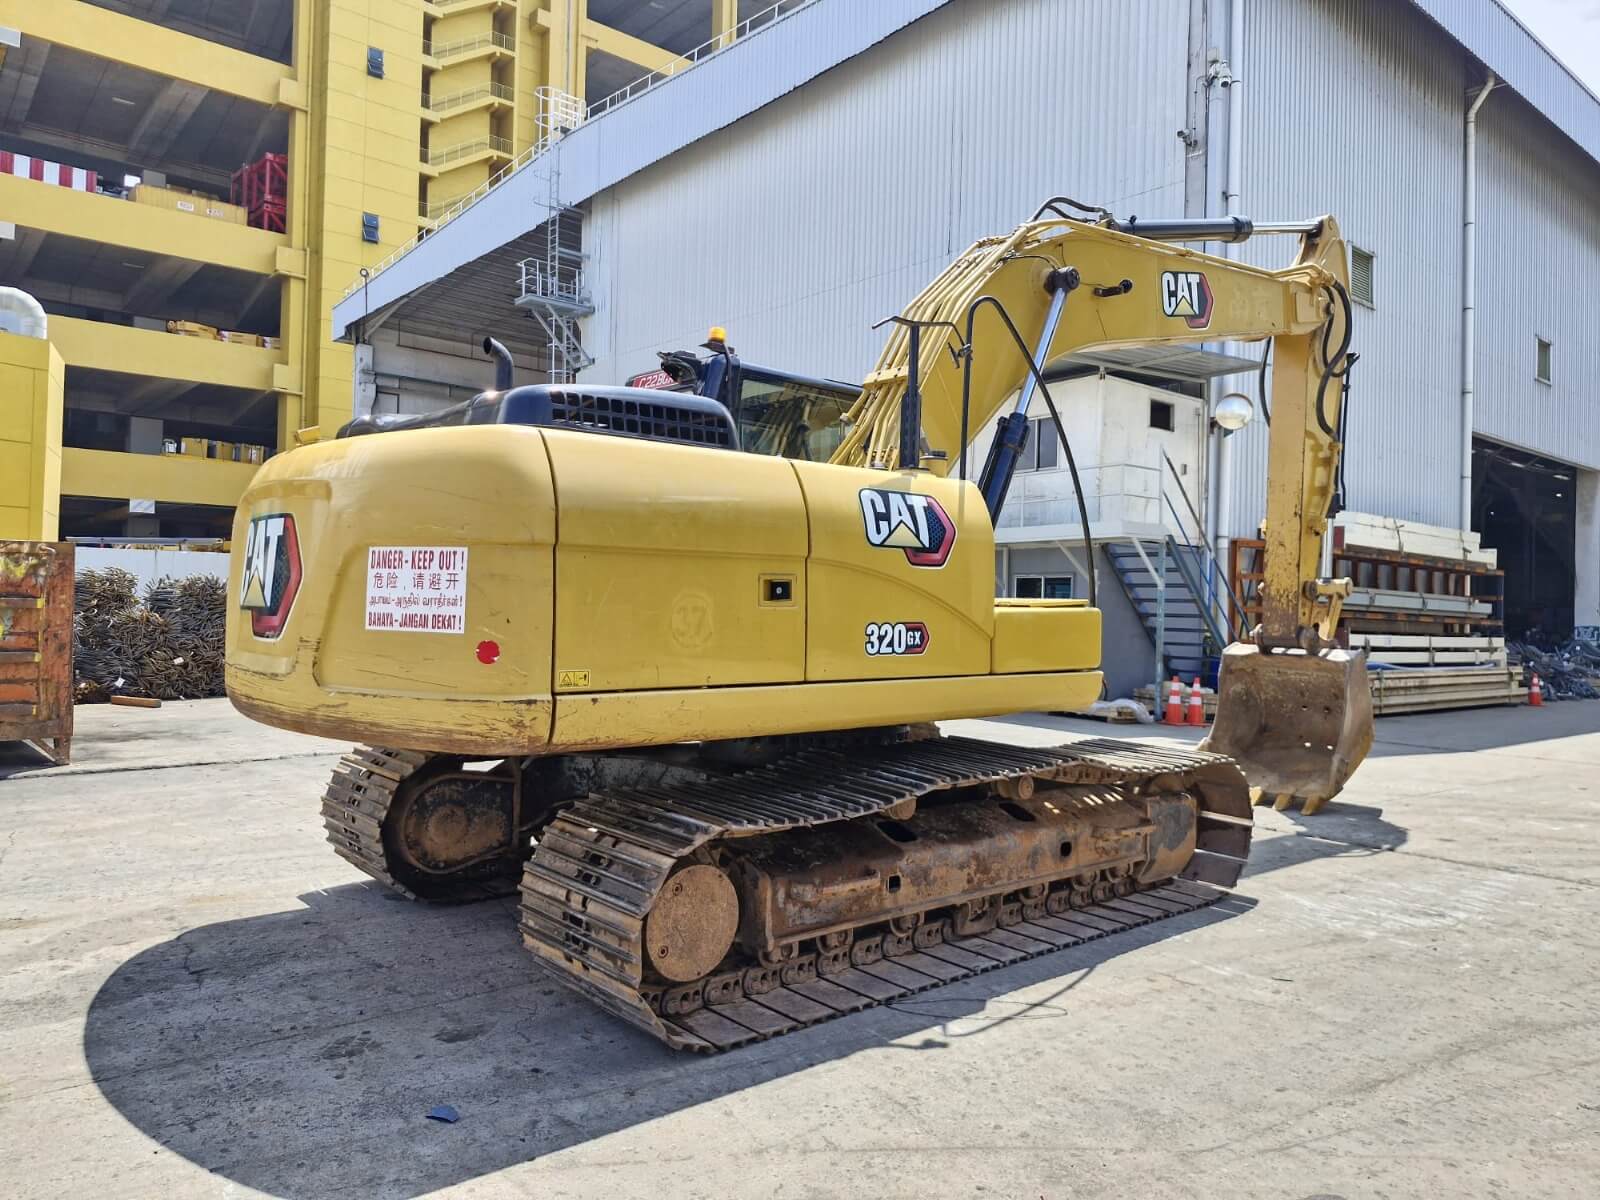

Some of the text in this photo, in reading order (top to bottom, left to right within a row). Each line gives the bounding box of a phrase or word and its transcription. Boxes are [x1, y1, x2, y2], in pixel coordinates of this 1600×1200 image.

[1162, 272, 1200, 315] CAT
[860, 489, 930, 548] CAT
[240, 518, 285, 608] CAT
[411, 550, 435, 570] KEEP
